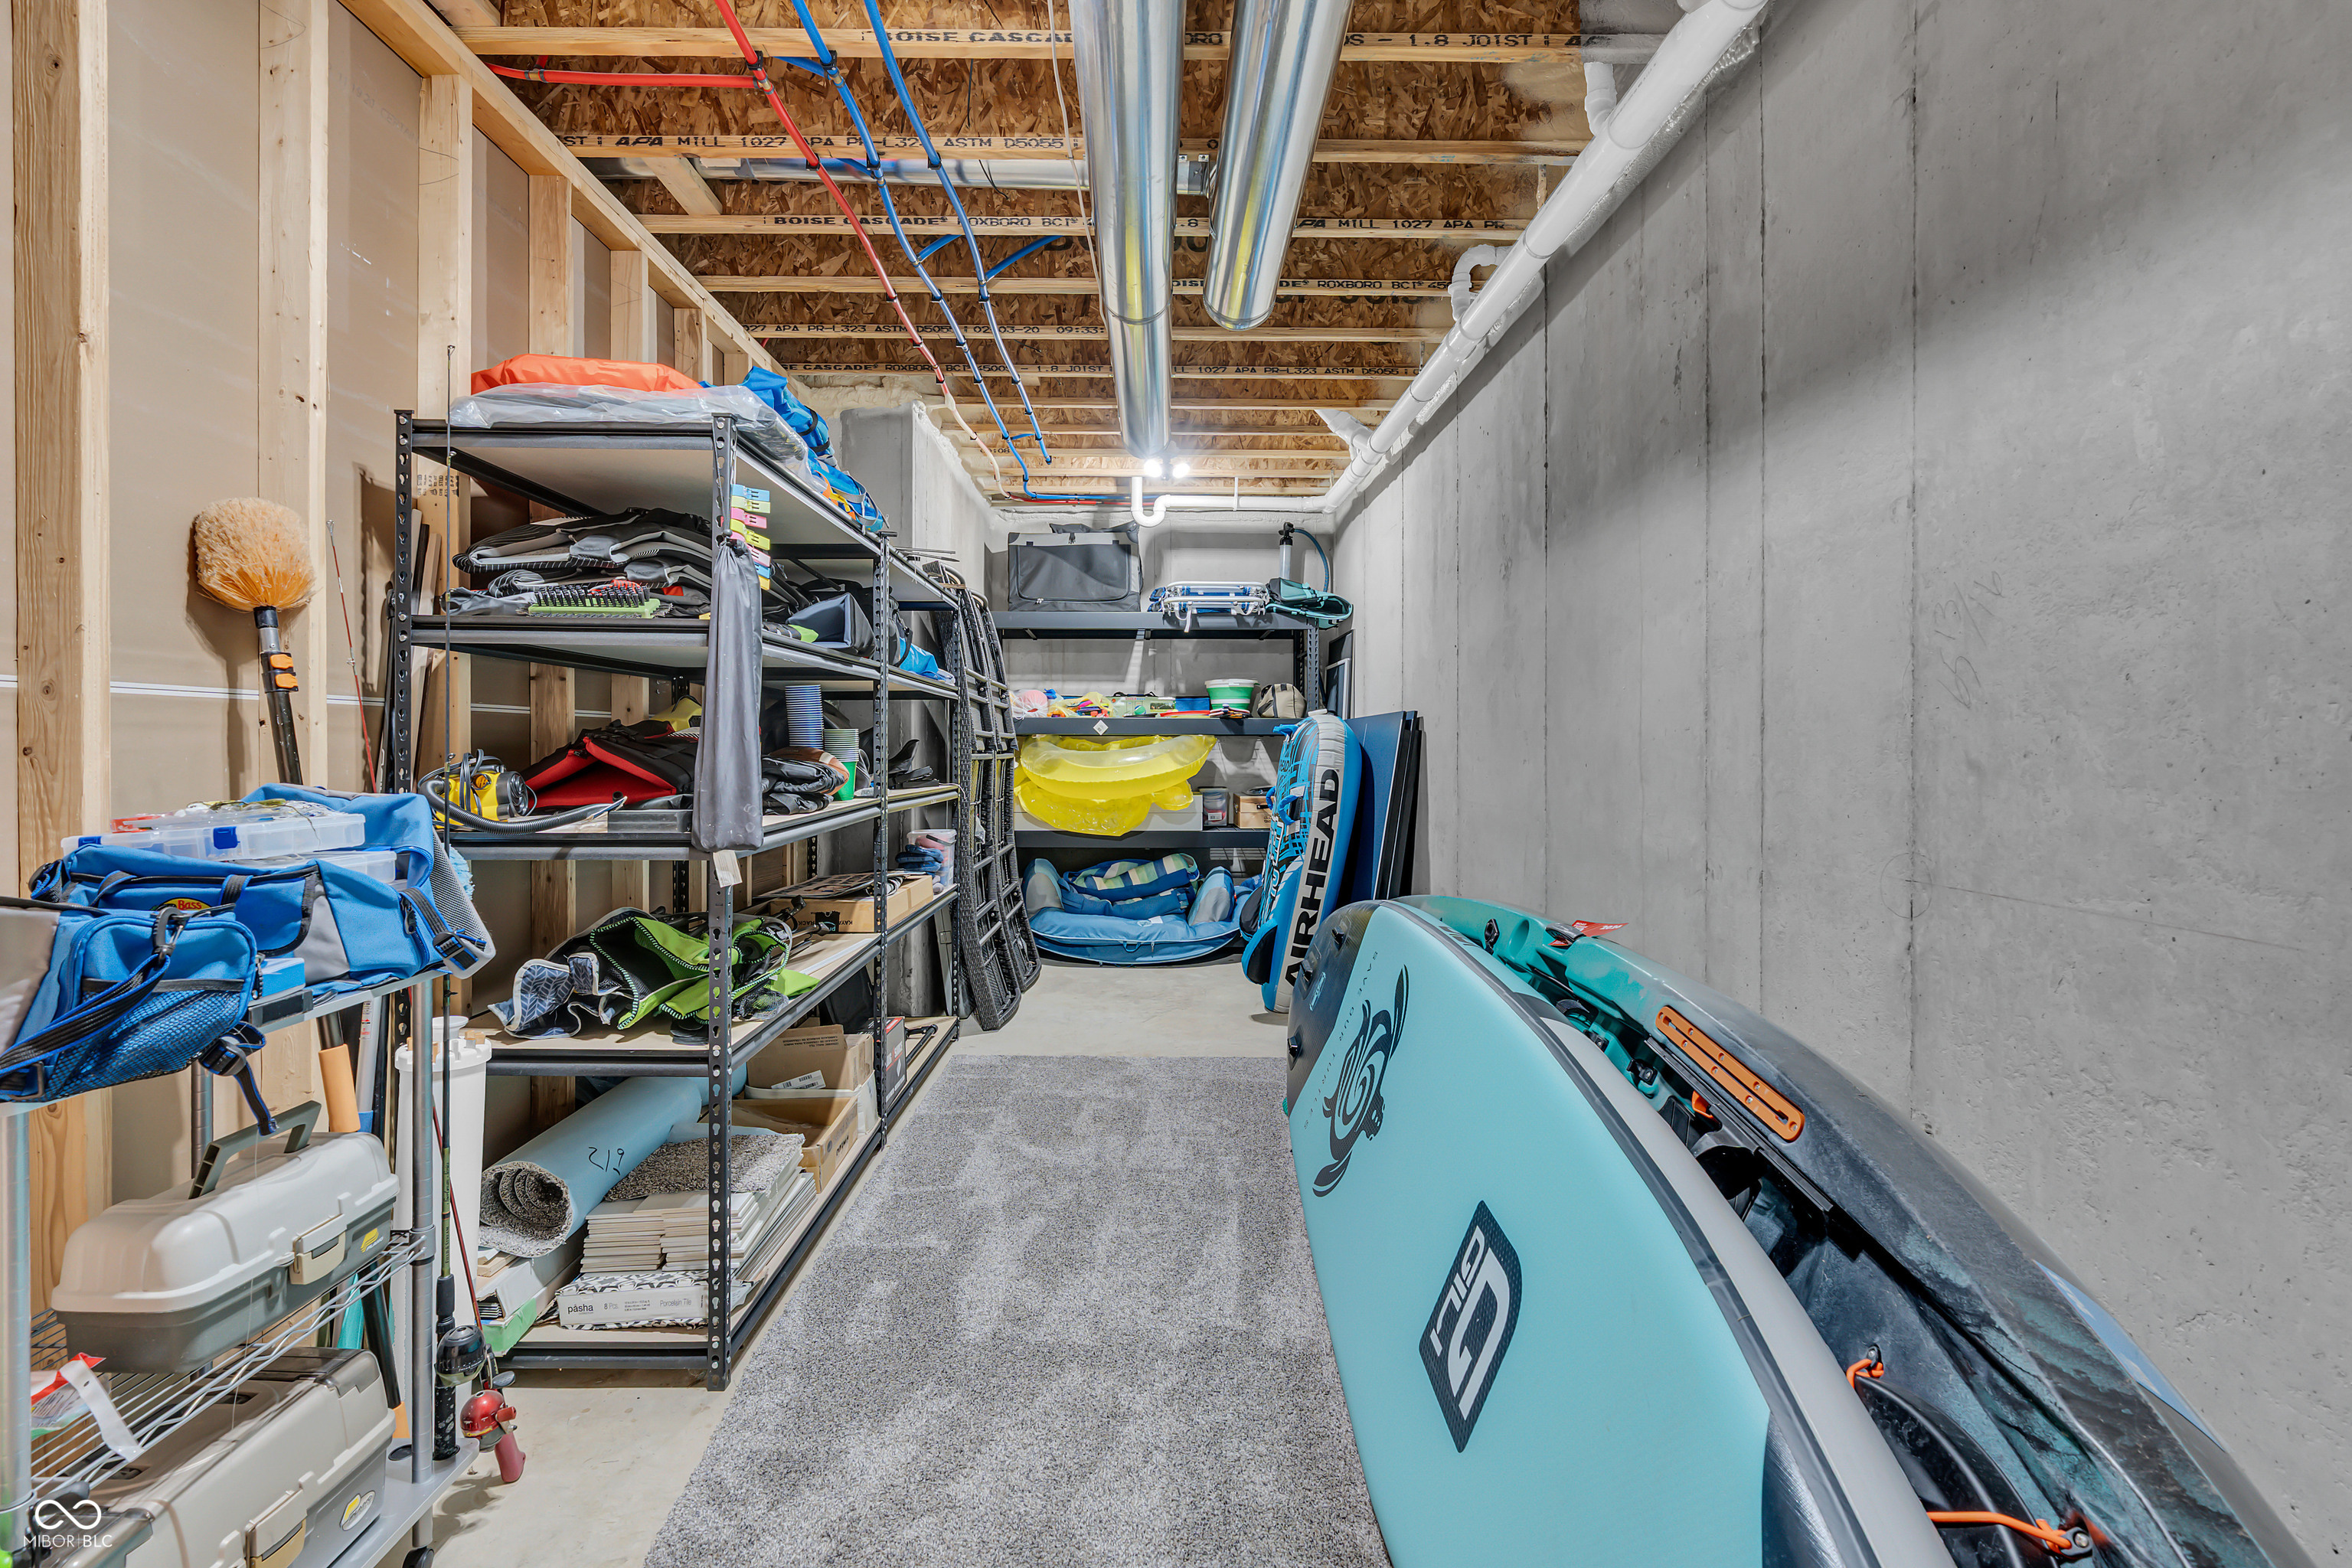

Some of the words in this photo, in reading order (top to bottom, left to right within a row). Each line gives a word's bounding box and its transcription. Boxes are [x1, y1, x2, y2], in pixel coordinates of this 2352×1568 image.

[1462, 34, 1534, 46] JOIST
[615, 136, 664, 145] APA
[678, 136, 727, 146] MILL
[740, 136, 788, 147] 1027
[846, 137, 932, 148] P-L32
[943, 138, 992, 147] ASTM
[1004, 138, 1064, 149] D5055
[1295, 219, 1326, 228] PA
[1338, 220, 1380, 228] MILL
[1393, 220, 1433, 229] 1027
[1442, 220, 1474, 229] APA
[1317, 280, 1383, 289] ROXBORO
[1285, 769, 1340, 988] AIRHEAD
[178, 900, 202, 911] Bass
[1357, 951, 1379, 996] SAVE
[1339, 1006, 1354, 1041] OUR
[1303, 1055, 1335, 1129] TURTLES
